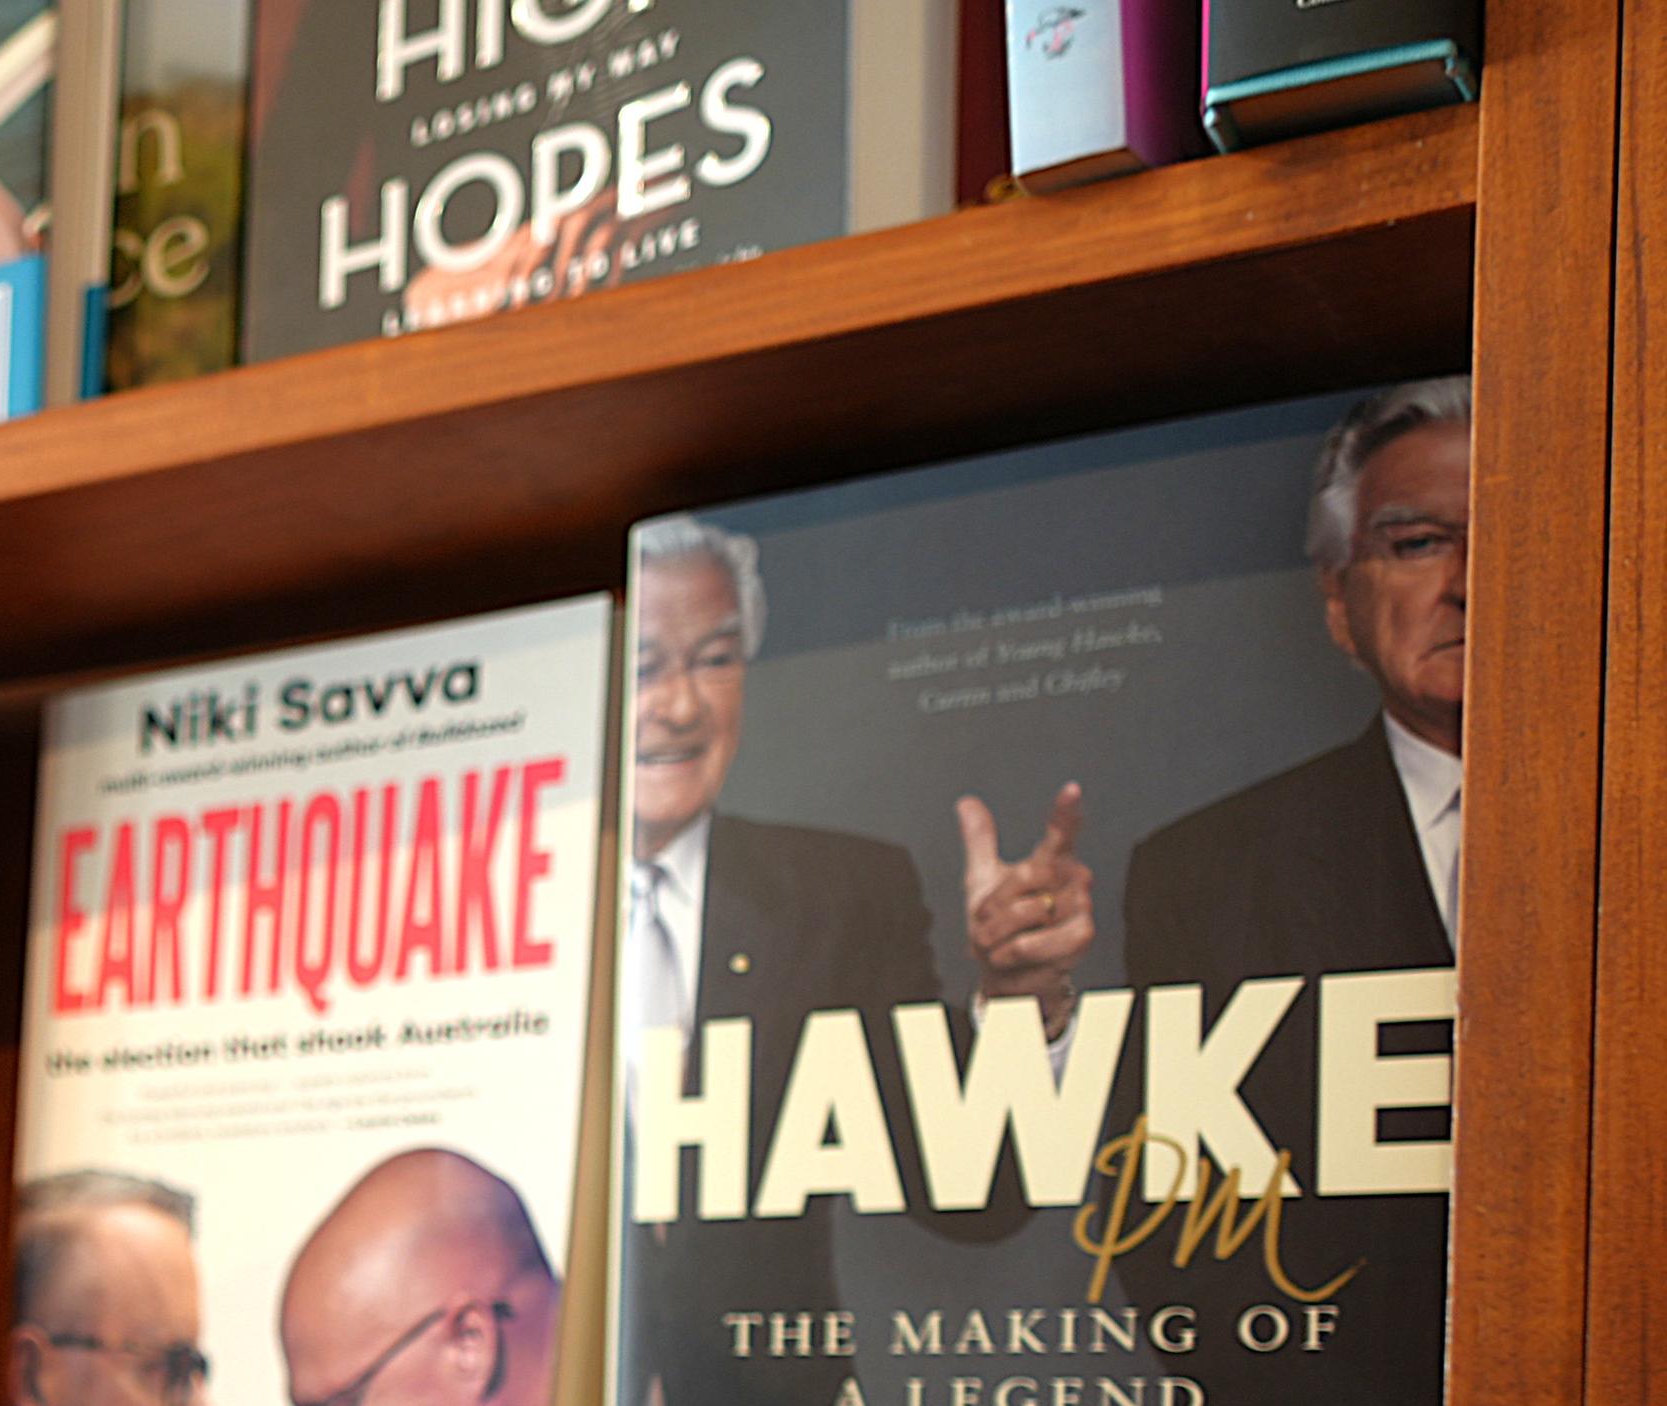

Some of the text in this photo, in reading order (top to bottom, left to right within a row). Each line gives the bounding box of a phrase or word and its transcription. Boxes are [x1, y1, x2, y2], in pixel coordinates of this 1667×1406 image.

[410, 28, 682, 148] LOSING MY WAY
[318, 56, 773, 310] HOPES
[618, 217, 701, 270] LIVE
[138, 657, 483, 757] Niki Savva
[51, 756, 568, 1019] EARTHQUAKE
[632, 967, 1457, 1223] HAWKE
[722, 1303, 1341, 1358] THE MAKING OF
